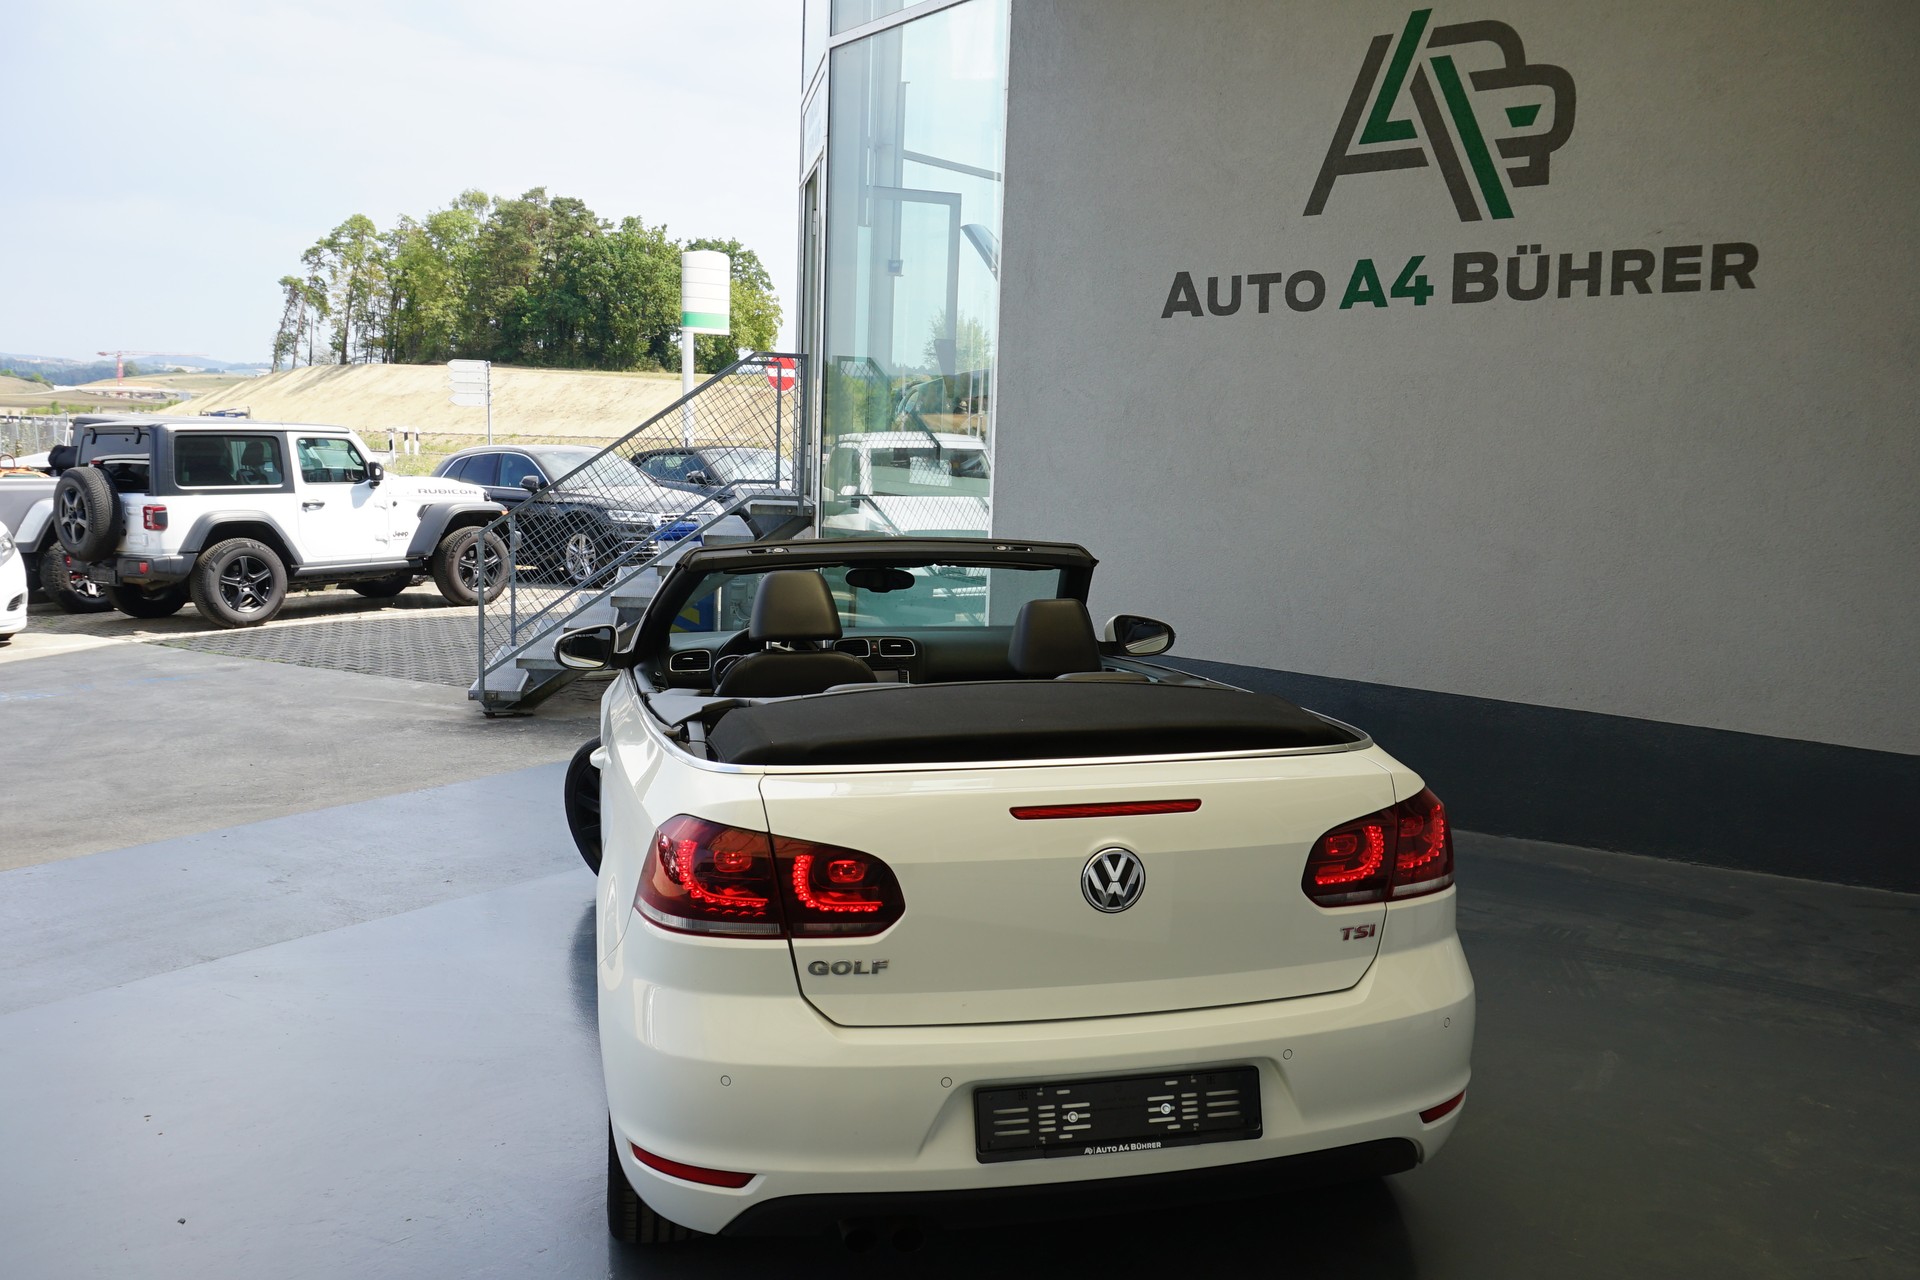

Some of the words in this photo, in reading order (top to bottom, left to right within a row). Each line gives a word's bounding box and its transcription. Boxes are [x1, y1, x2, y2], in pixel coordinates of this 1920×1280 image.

[1161, 270, 1326, 319] AUTO
[1339, 255, 1434, 310] A4
[1452, 242, 1759, 304] BÜHRER
[1340, 923, 1376, 941] TSI
[808, 959, 889, 976] GOLF
[1096, 1145, 1117, 1154] AUTO
[1118, 1143, 1129, 1152] A4
